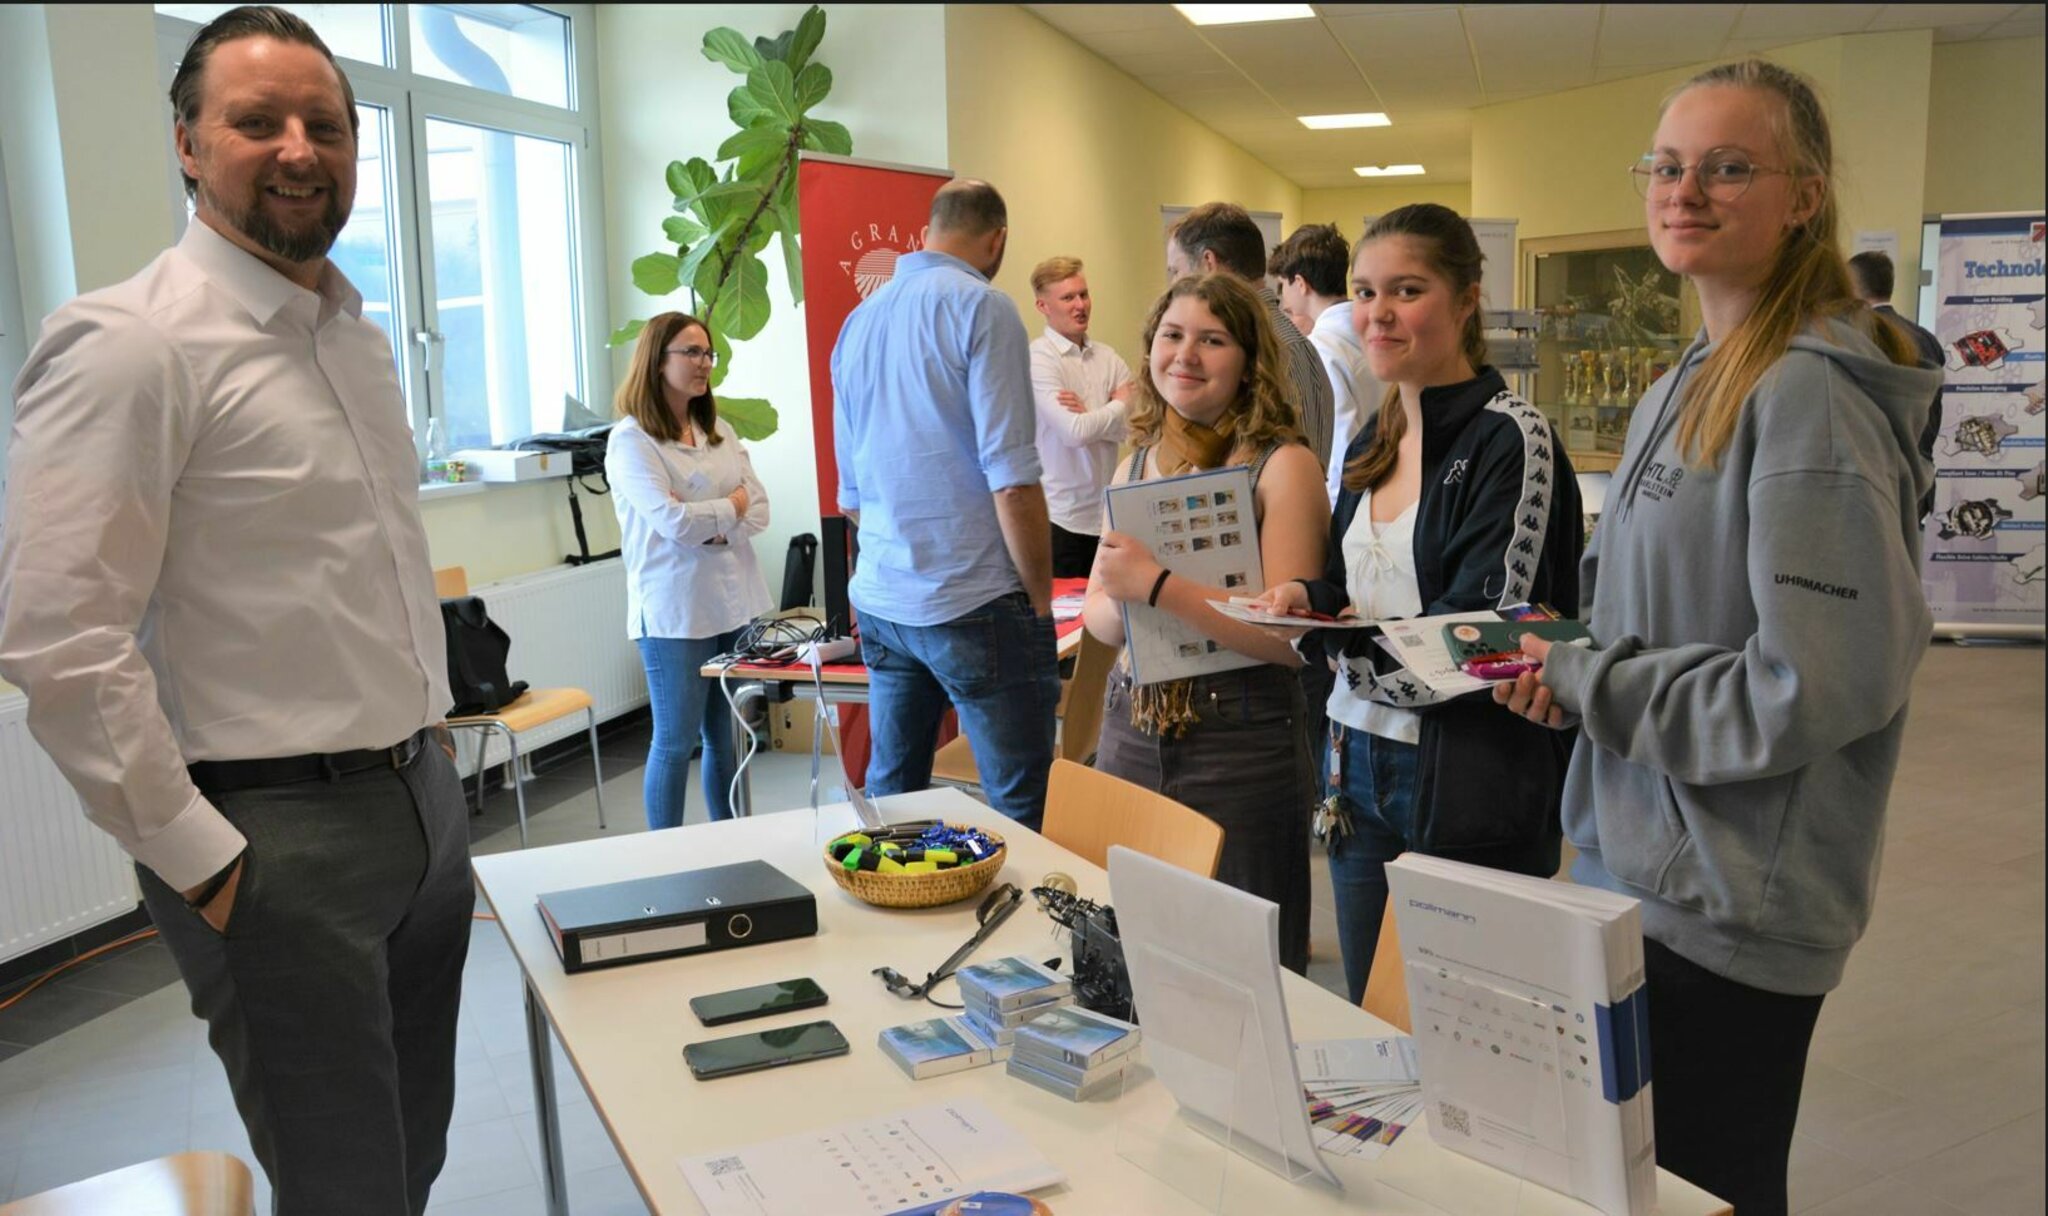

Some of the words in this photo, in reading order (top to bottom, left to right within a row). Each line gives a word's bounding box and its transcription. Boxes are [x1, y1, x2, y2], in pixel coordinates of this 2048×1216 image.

[839, 223, 921, 276] AGRAN
[1645, 463, 1666, 481] HTL
[1774, 573, 1858, 600] UHRMACHER
